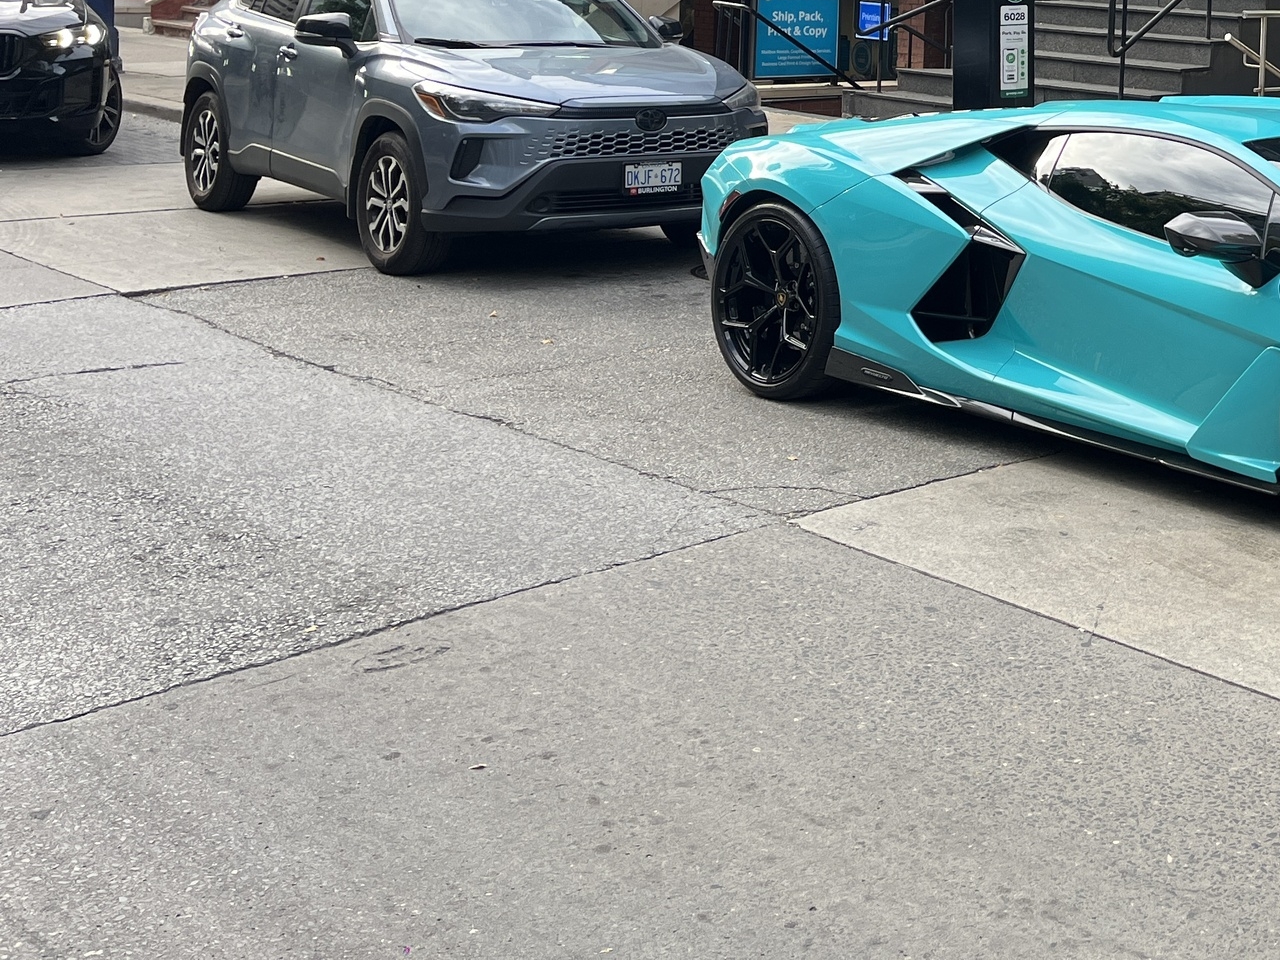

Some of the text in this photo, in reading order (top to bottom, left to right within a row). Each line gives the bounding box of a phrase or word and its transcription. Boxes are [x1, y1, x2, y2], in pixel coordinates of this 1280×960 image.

[772, 10, 824, 24] Ship, Pack,
[1003, 12, 1026, 21] 6028
[793, 25, 828, 38] & Copy
[626, 167, 680, 186] DKJF 672
[637, 185, 678, 194] BURLINGTON
